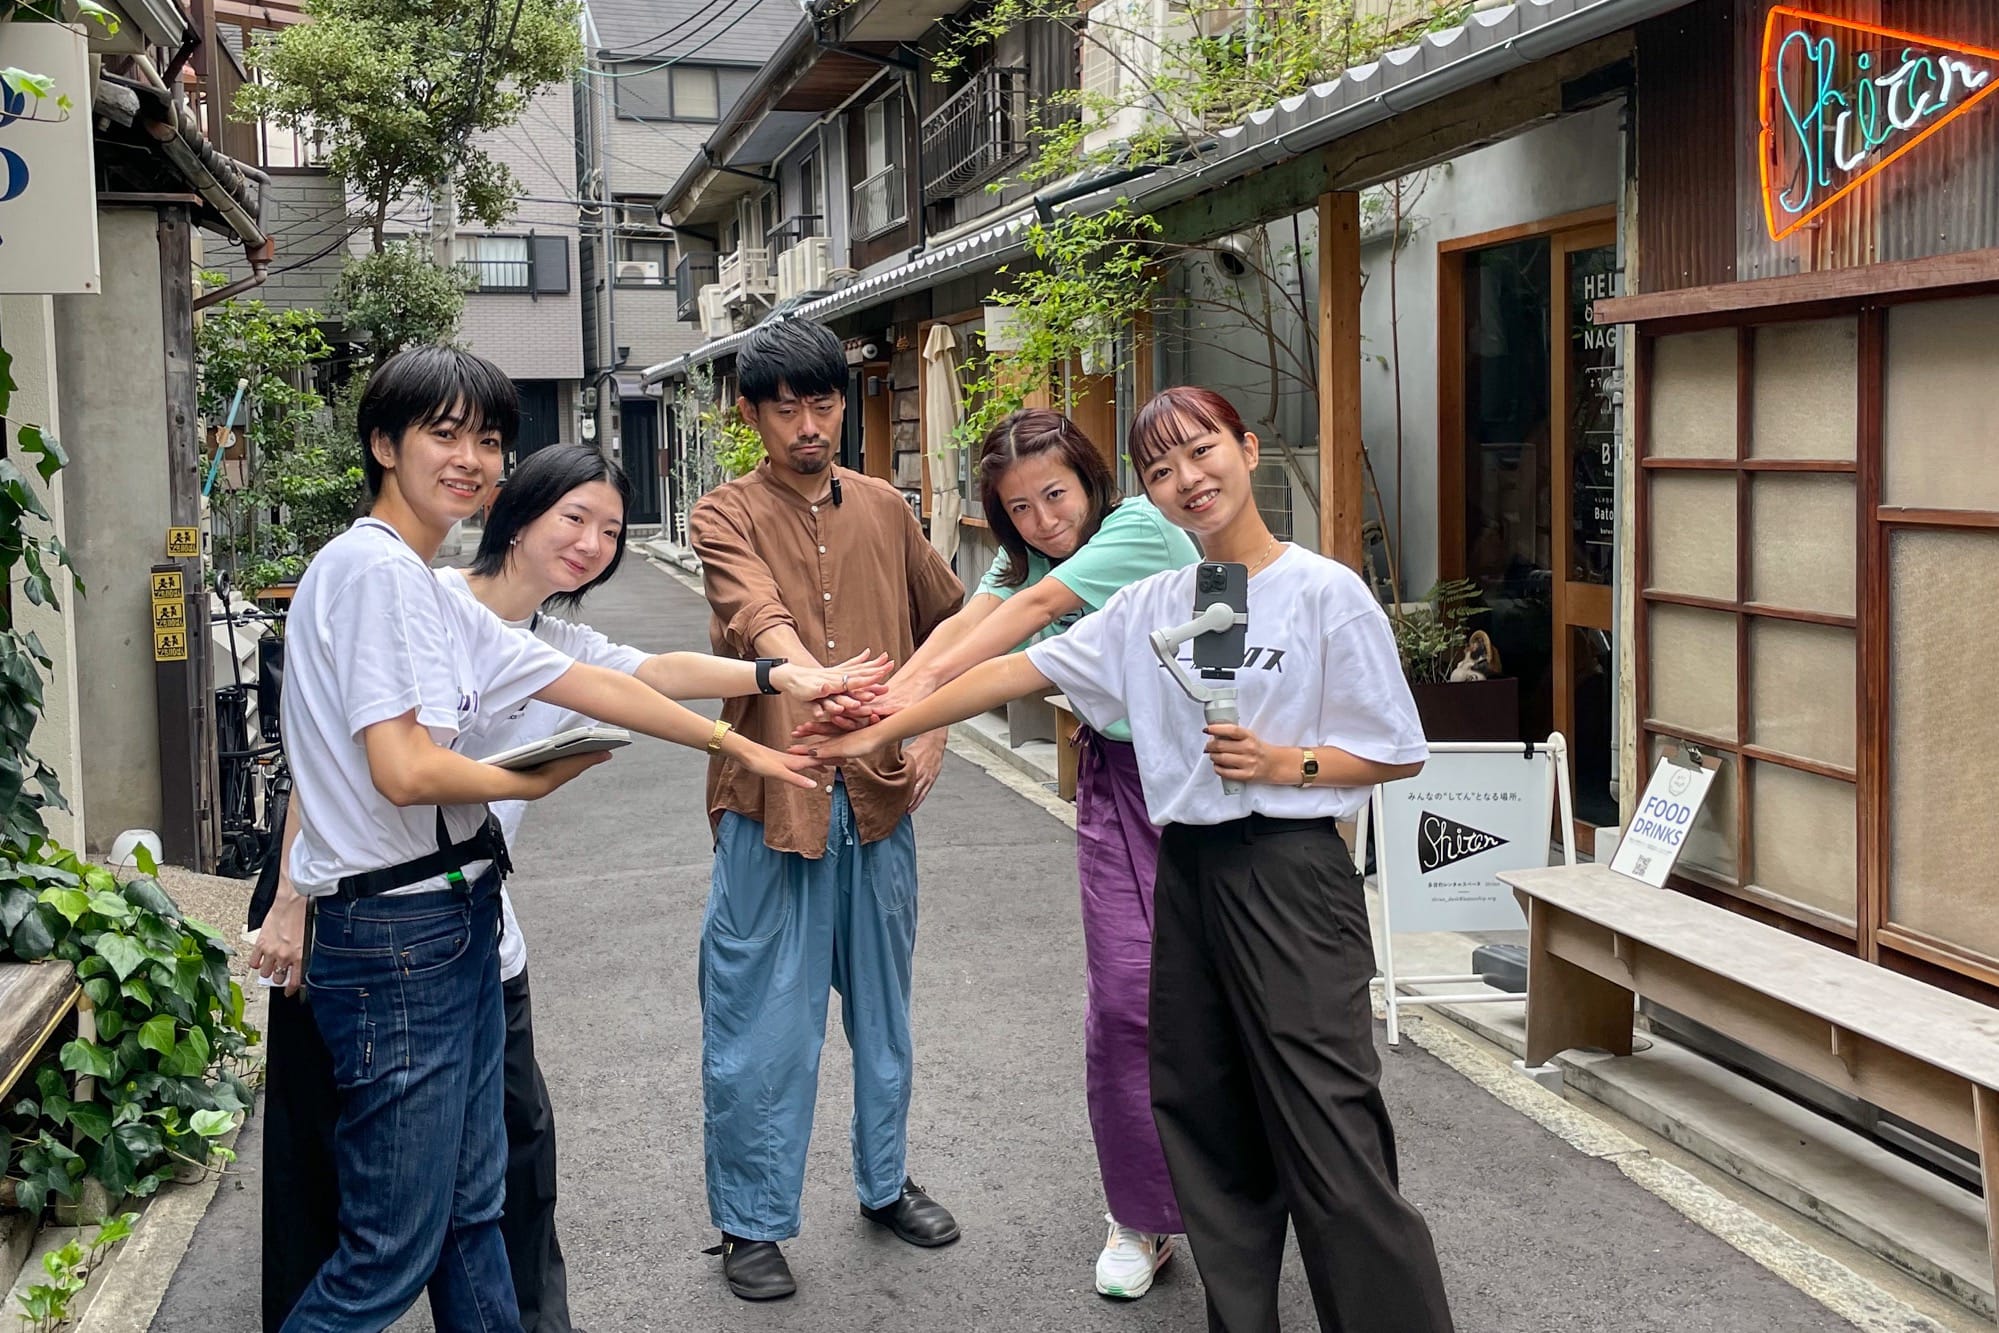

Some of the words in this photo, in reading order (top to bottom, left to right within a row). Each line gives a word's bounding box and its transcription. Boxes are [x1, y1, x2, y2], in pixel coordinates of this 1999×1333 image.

[1584, 273, 1615, 300] HEL
[1584, 328, 1616, 350] NAG
[1643, 796, 1691, 825] FOOD
[1633, 817, 1684, 846] DRINKS
